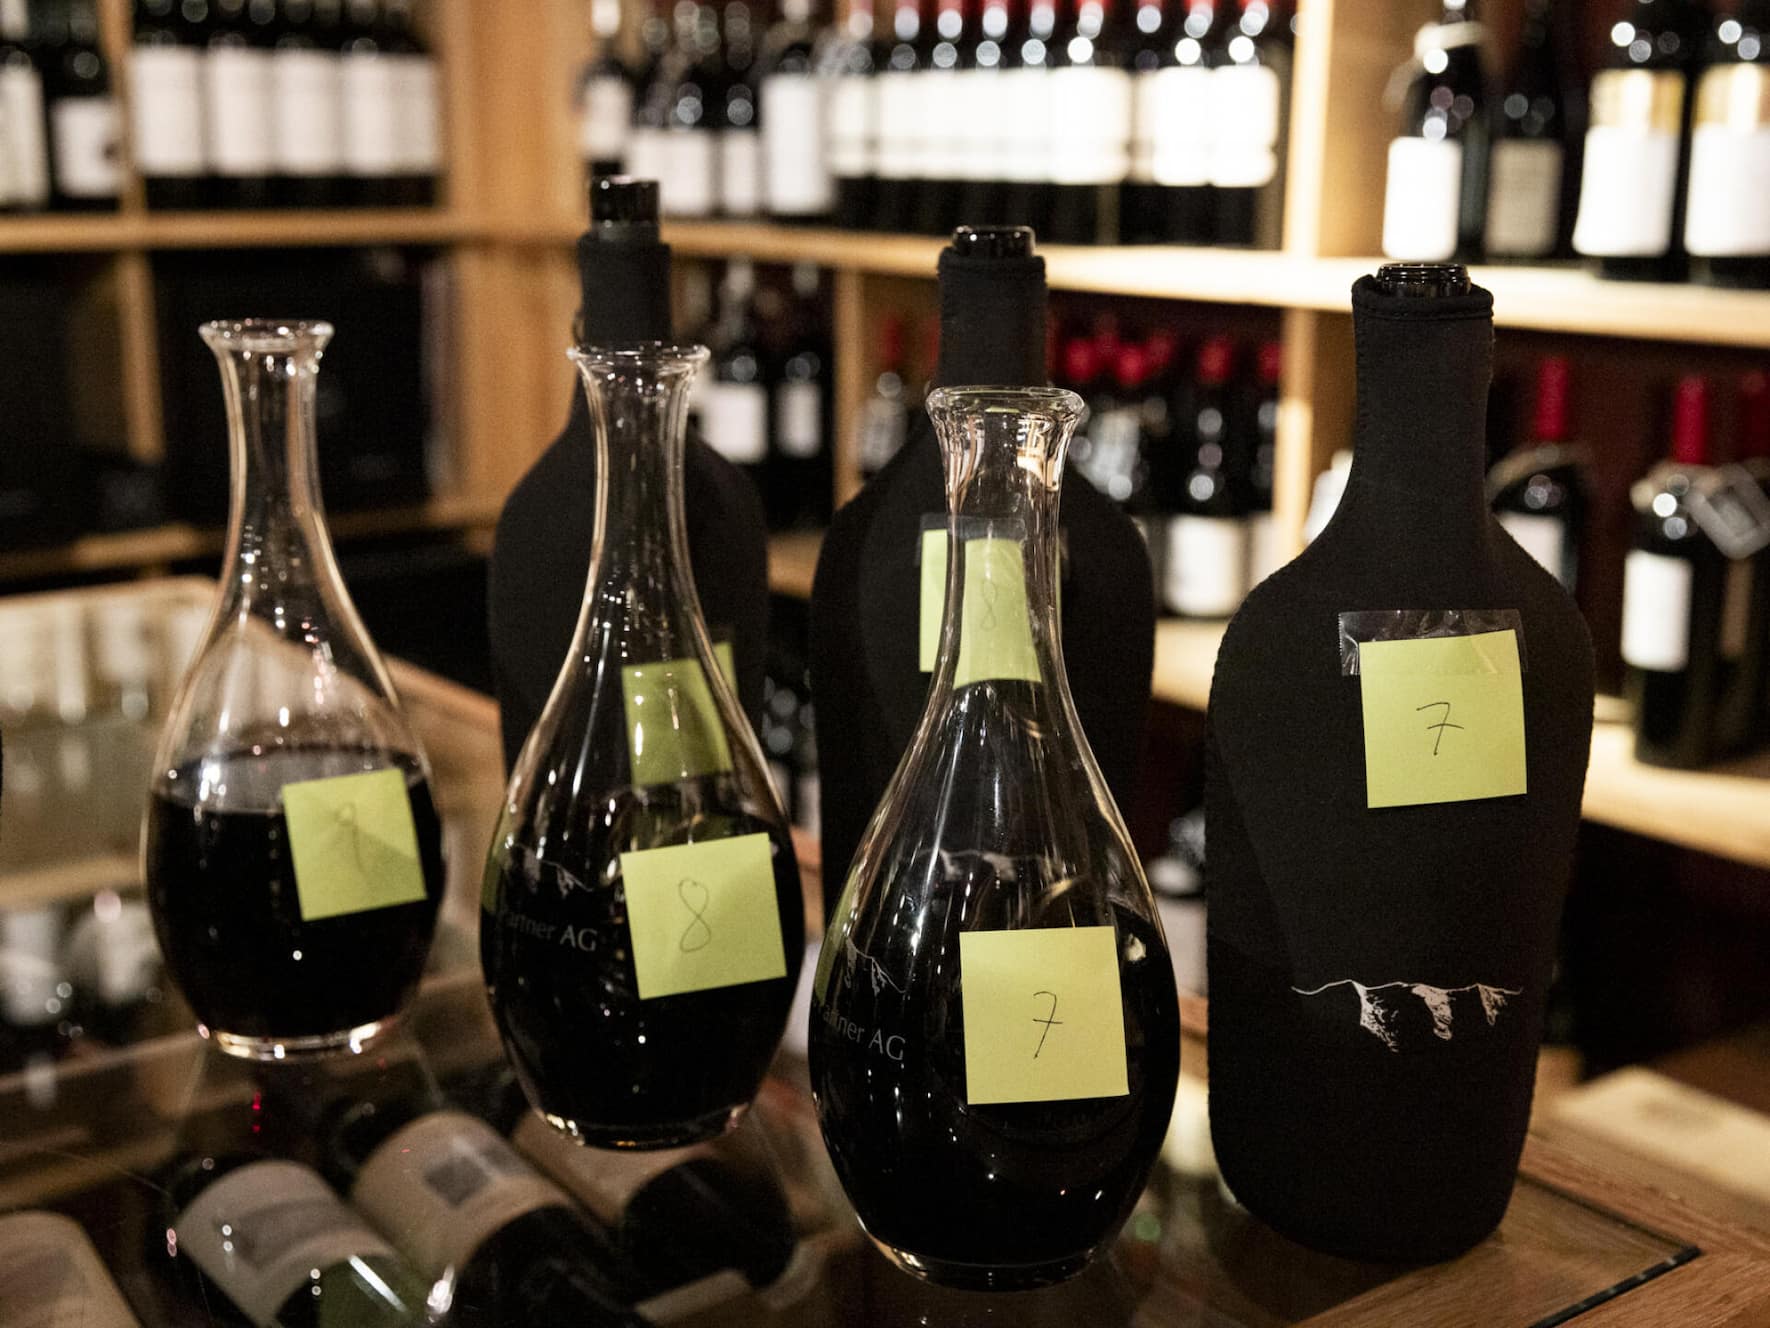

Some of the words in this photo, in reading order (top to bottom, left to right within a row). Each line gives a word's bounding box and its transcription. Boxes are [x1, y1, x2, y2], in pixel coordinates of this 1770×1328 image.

[1416, 701, 1464, 756] 7
[559, 923, 599, 952] AG
[680, 877, 711, 952] 8
[867, 1026, 908, 1061] AG
[1033, 991, 1065, 1059] 7
